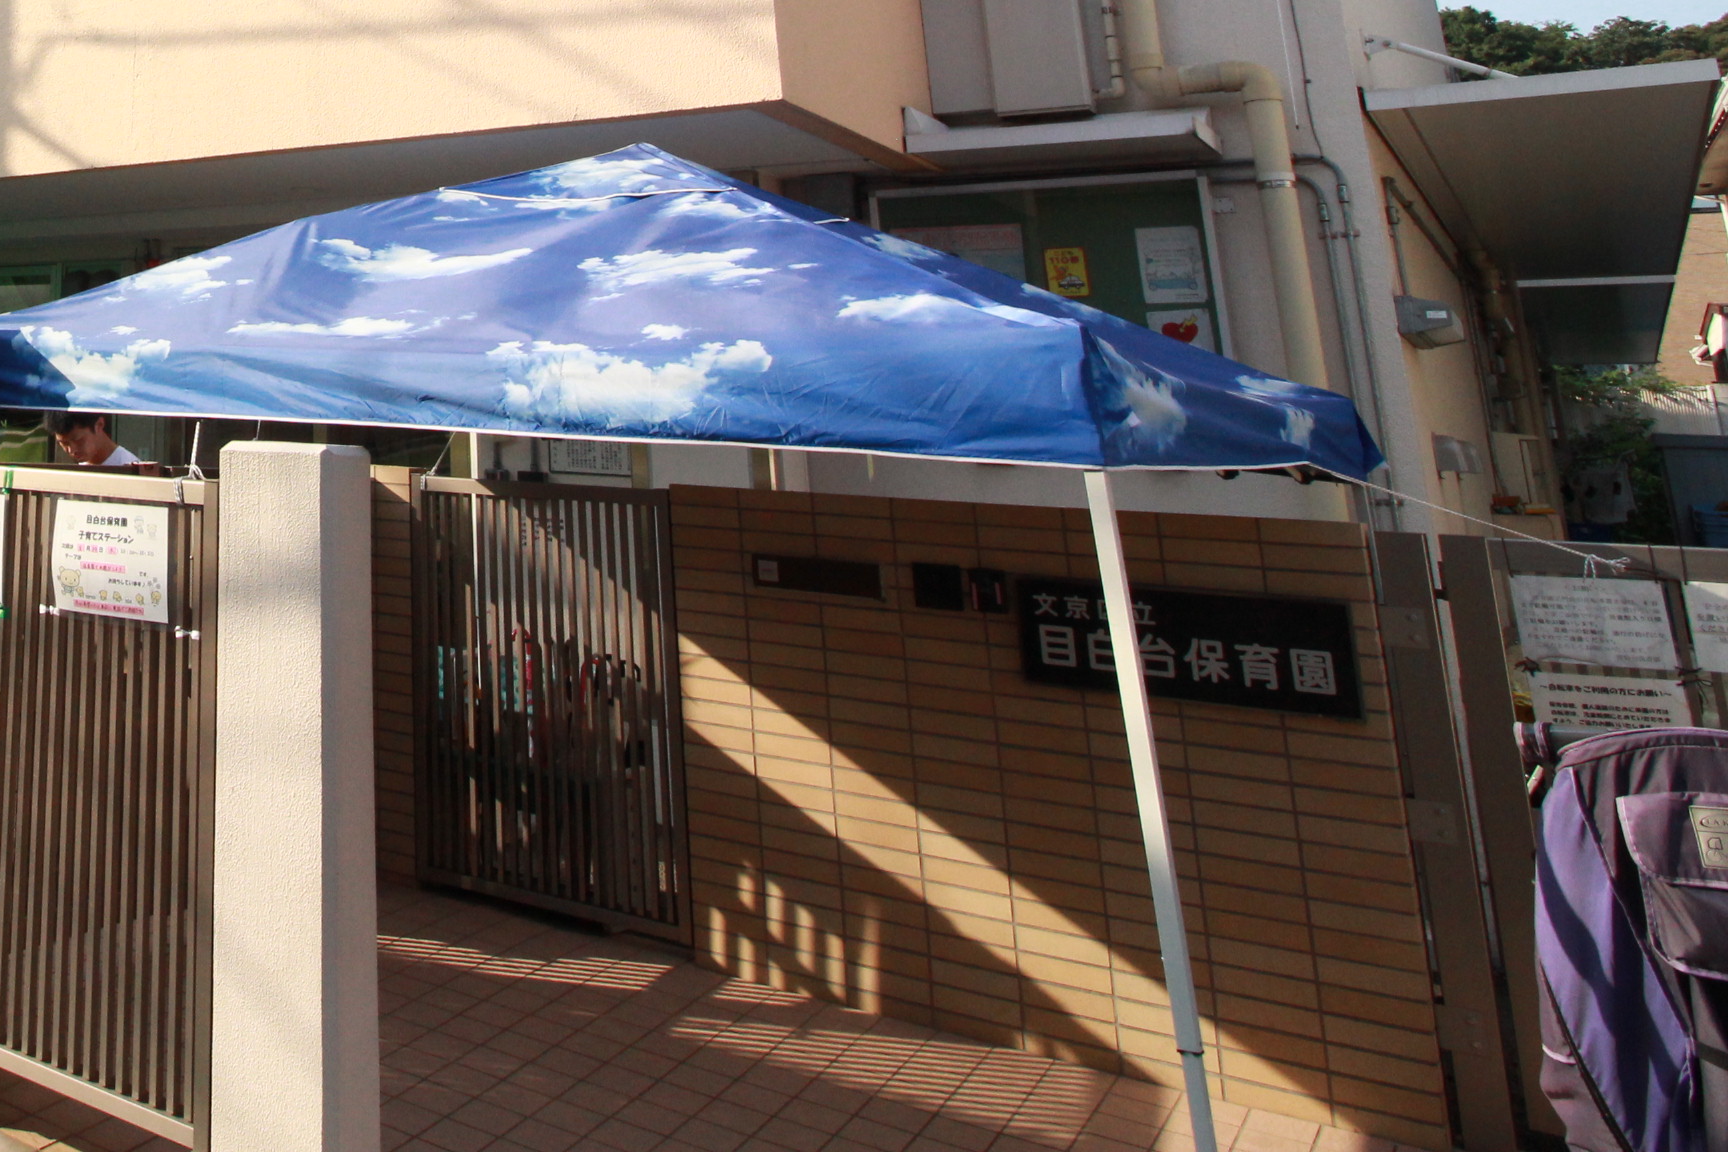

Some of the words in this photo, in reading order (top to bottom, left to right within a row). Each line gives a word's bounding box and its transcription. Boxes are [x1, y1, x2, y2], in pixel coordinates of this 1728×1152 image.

[86, 514, 128, 527] 目白台保育園
[78, 530, 134, 544] 子育てステーション
[1038, 625, 1338, 696] 目白台保育園
